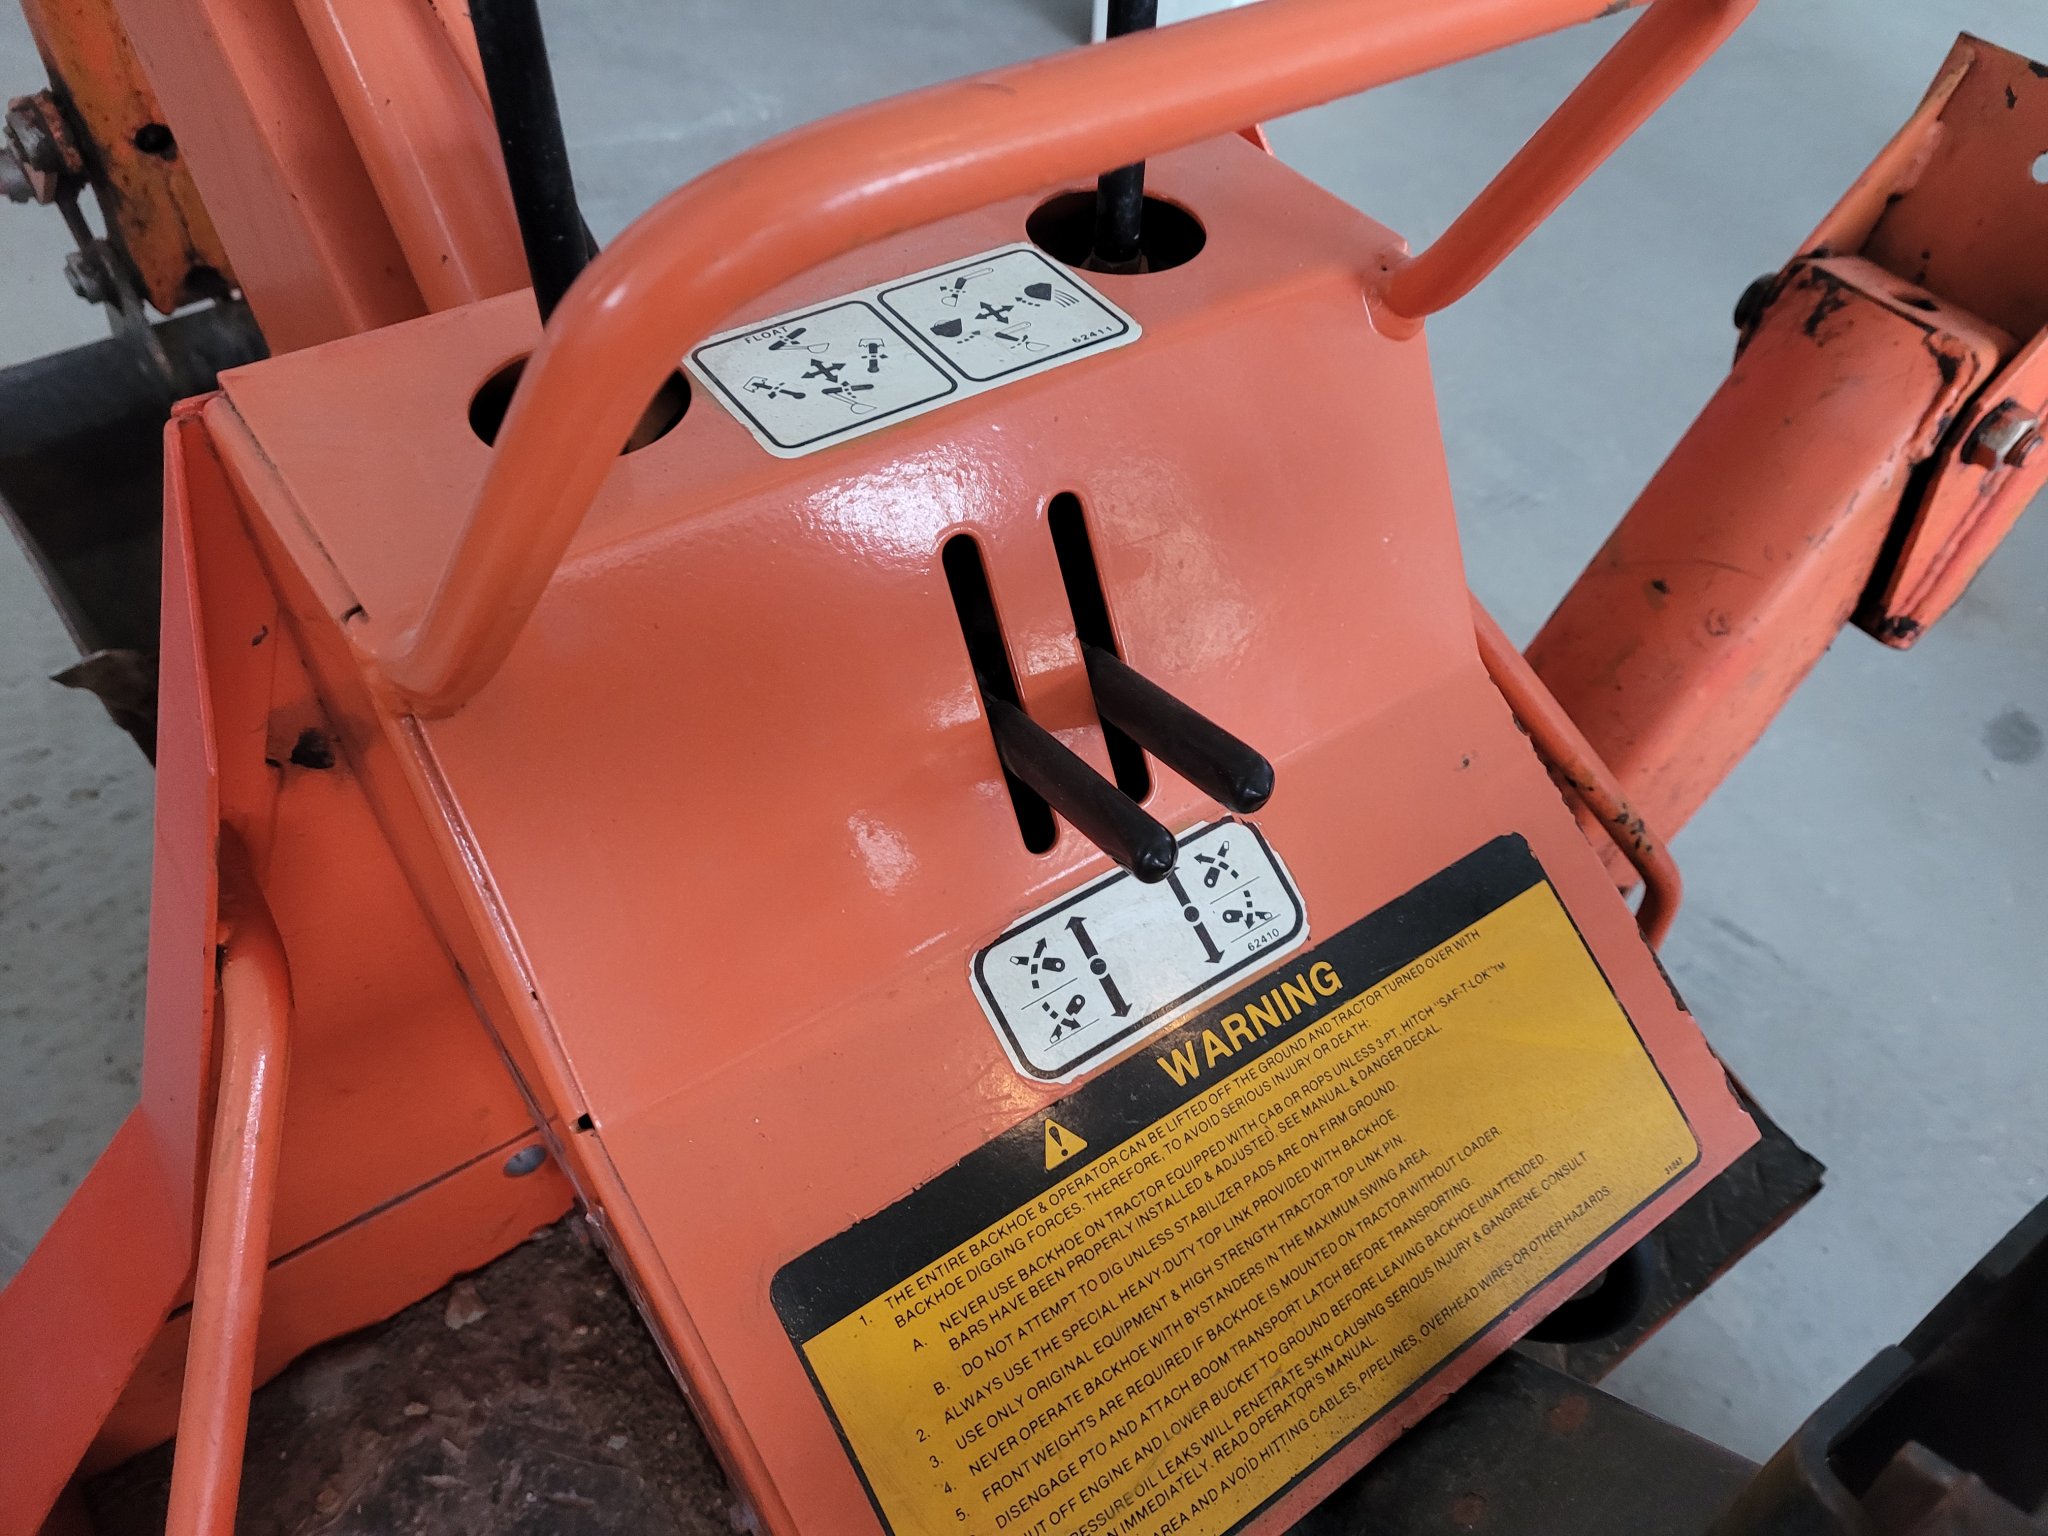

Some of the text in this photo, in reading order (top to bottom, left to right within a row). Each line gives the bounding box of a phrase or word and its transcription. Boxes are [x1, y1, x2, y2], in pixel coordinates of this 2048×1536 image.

[744, 326, 788, 344] FLOAT
[1072, 326, 1113, 343] 62411
[1157, 961, 1343, 1087] WARNING
[1247, 928, 1280, 951] 62410
[859, 929, 1480, 1326] 1. THE ENTIRE BACKHOE & OPERATOR CAN BE LIFTED OFF THE GROUND AND TRACTOR TURNED OVER WITH
[894, 1020, 1371, 1328] BACKHOE DIGGING FORCES. THEREFORE, TO AVOID SERIOUS INJURY OR DEATH:
[913, 1005, 1434, 1352] A. NEVER USE BACKHOE ON TRACTOR EQUIPPED WITH CAB ROPS UNLESS HITCH
[916, 1109, 1399, 1443] 2. ALWAYS USE THE SPECIAL HEAVY-DUTY TOP LINK PROVIDED WITH BACKHOE.
[933, 1080, 1399, 1396] B. DO NOT ATTEMPT TO DIG UNLESS STABILIZER PADS ARE ON FIRM GROUND.
[948, 1024, 1442, 1351] BARS HAVE BEEN PROPERLY INSTALLED & ADJUSTED. SEE MANUAL & DANGER DECAL.
[929, 1134, 1407, 1468] 3. USE ONLY ORIGINAL EQUIPMENT & HIGH STRENGTH TRACTOR TOP LINK PIN.
[955, 1126, 1502, 1521] 5. FRONT WEIGHTS ARE REQUIRED IF BACKHOE IS MOUNTED ON TRACTOR WITHOUT LOADER.
[968, 1149, 1431, 1476] NEVER OPERATE BACKHOE WITH BYSTANDERS IN THE MAXIMUM SWING AREA.
[995, 1236, 1389, 1529] DISENGAGE PTO AND ATTACH BOOM TRANSPORT LATCH BEFORE
[1049, 1202, 1479, 1525] OFF ENGINE AND LOWER BUCKET TO GROUND BEFORE LEAVING BACKHOE
[1120, 1336, 1379, 1533] IMMEDIATELY. READ OPERATOR'S MANUAL.
[1133, 1237, 1471, 1498] OIL LEAKS WILL PENETRATE SKIN CAUSING SERIOUS INJURY
[1191, 1287, 1479, 1517] AND AVOID HITTING CABLES, PIPELINES, OVERHEAD
